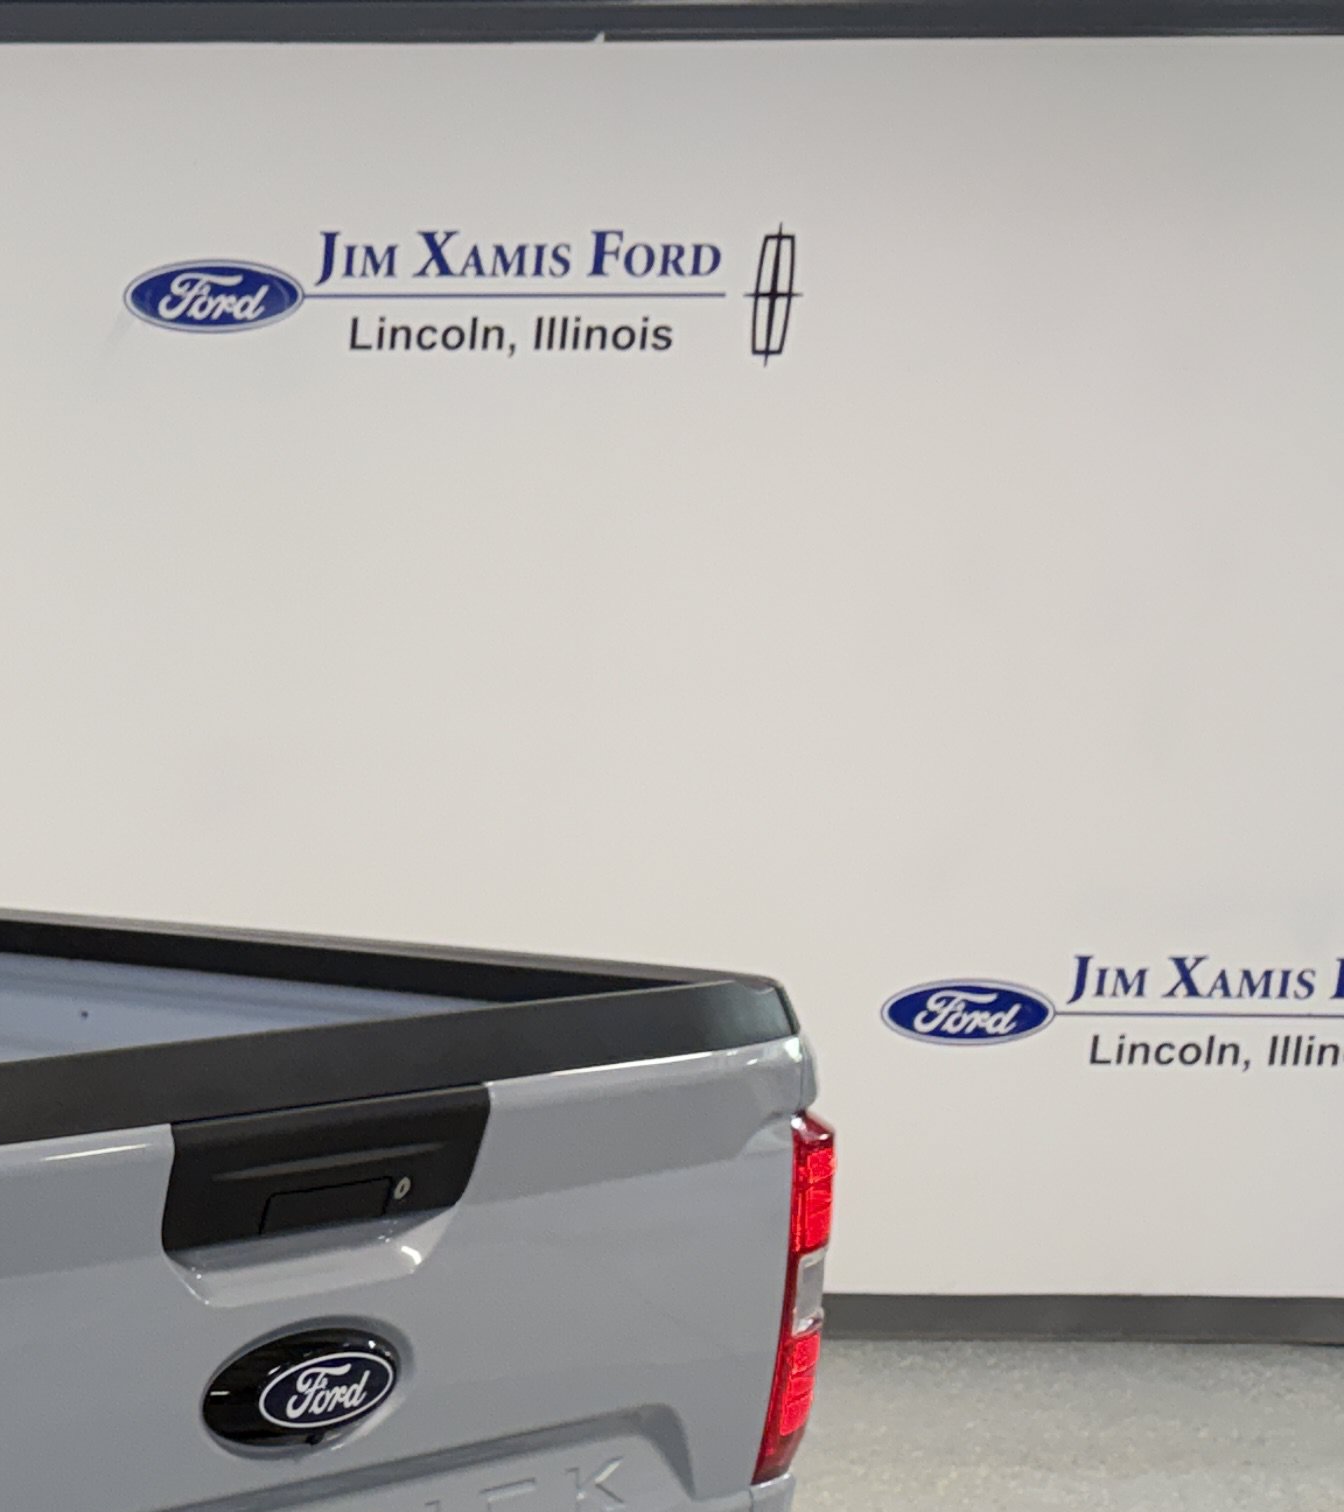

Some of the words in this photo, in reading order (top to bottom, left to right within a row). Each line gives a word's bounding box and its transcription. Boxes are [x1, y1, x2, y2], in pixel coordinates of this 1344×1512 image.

[315, 232, 397, 286] JIM
[413, 231, 570, 277] XAMIS
[588, 230, 721, 276] FORD
[158, 273, 265, 321] Ford
[350, 317, 515, 356] Lincoln,
[534, 317, 672, 350] Illinois
[1066, 955, 1149, 1004] JIM
[1163, 956, 1315, 999] XAMIS
[914, 990, 1020, 1035] Ford
[1090, 1035, 1250, 1070] Lincoln,
[1268, 1035, 1344, 1067] Illin
[285, 1366, 368, 1418] Ford
